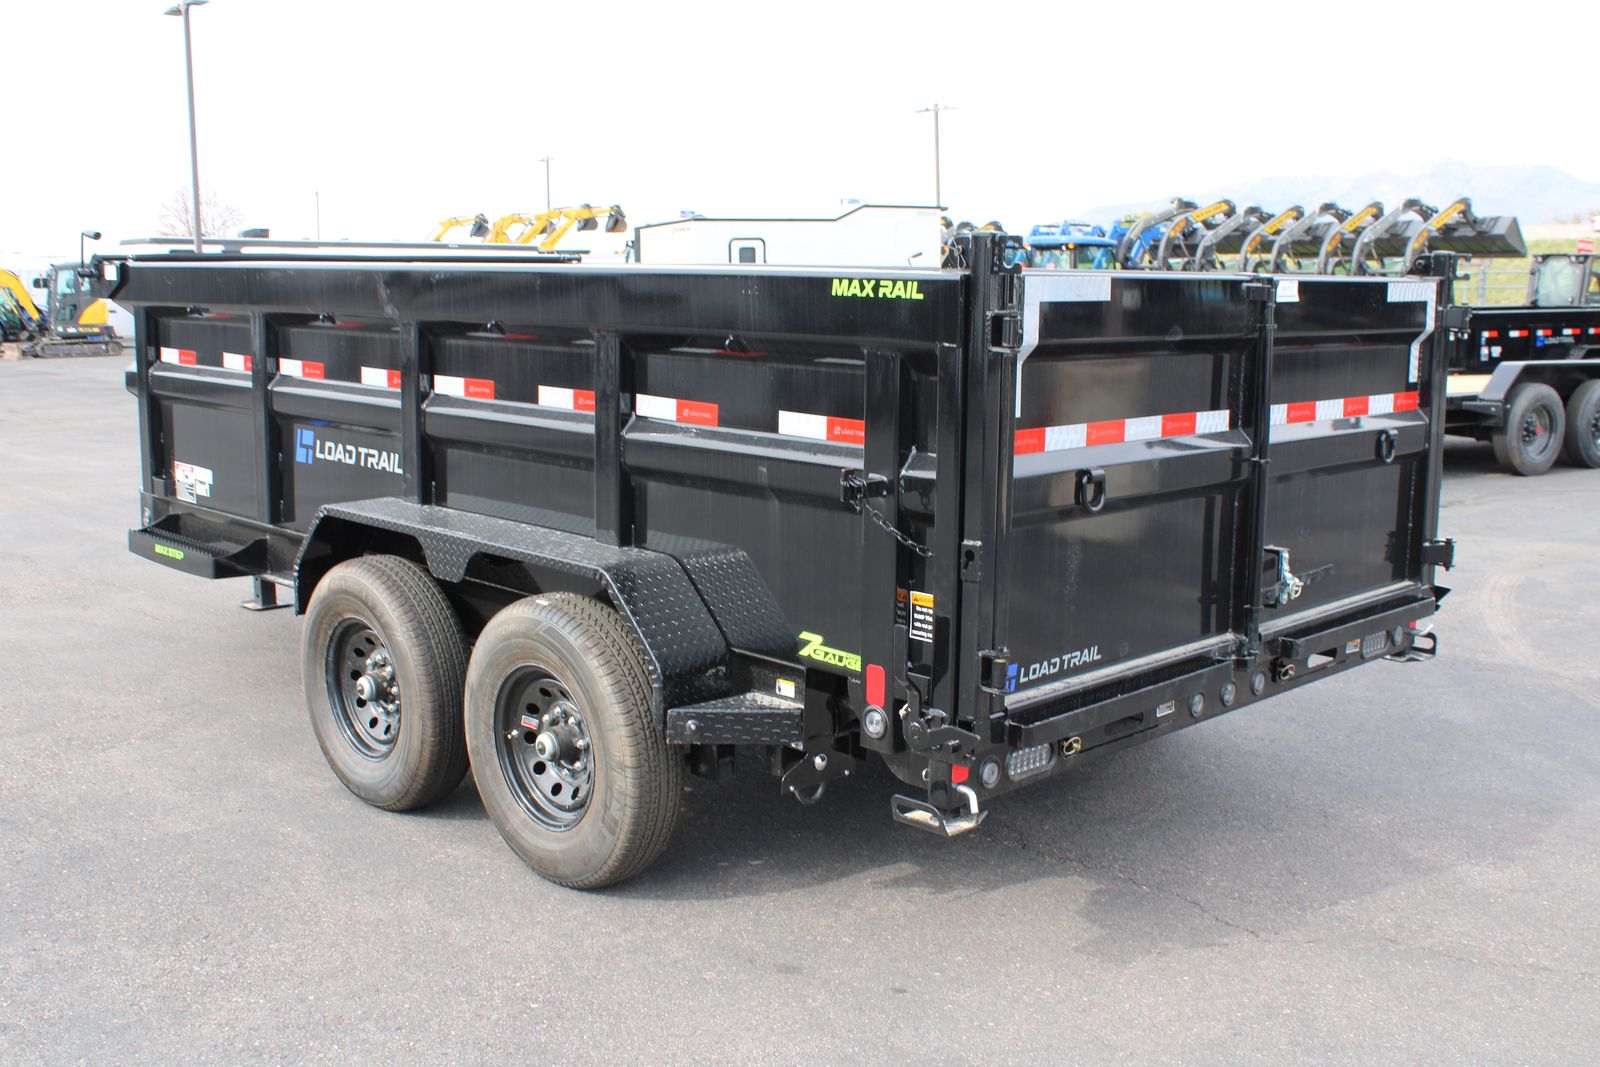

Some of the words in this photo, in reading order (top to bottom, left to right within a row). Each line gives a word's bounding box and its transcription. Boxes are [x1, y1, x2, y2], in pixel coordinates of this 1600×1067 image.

[832, 278, 875, 297] MAX
[878, 280, 924, 299] RAIL
[315, 439, 357, 465] LOAD
[358, 446, 403, 475] TRAIL
[798, 630, 823, 657] 7
[809, 645, 862, 672] GAUGE
[1019, 656, 1060, 684] LOAD
[1062, 645, 1102, 671] TRAIL
